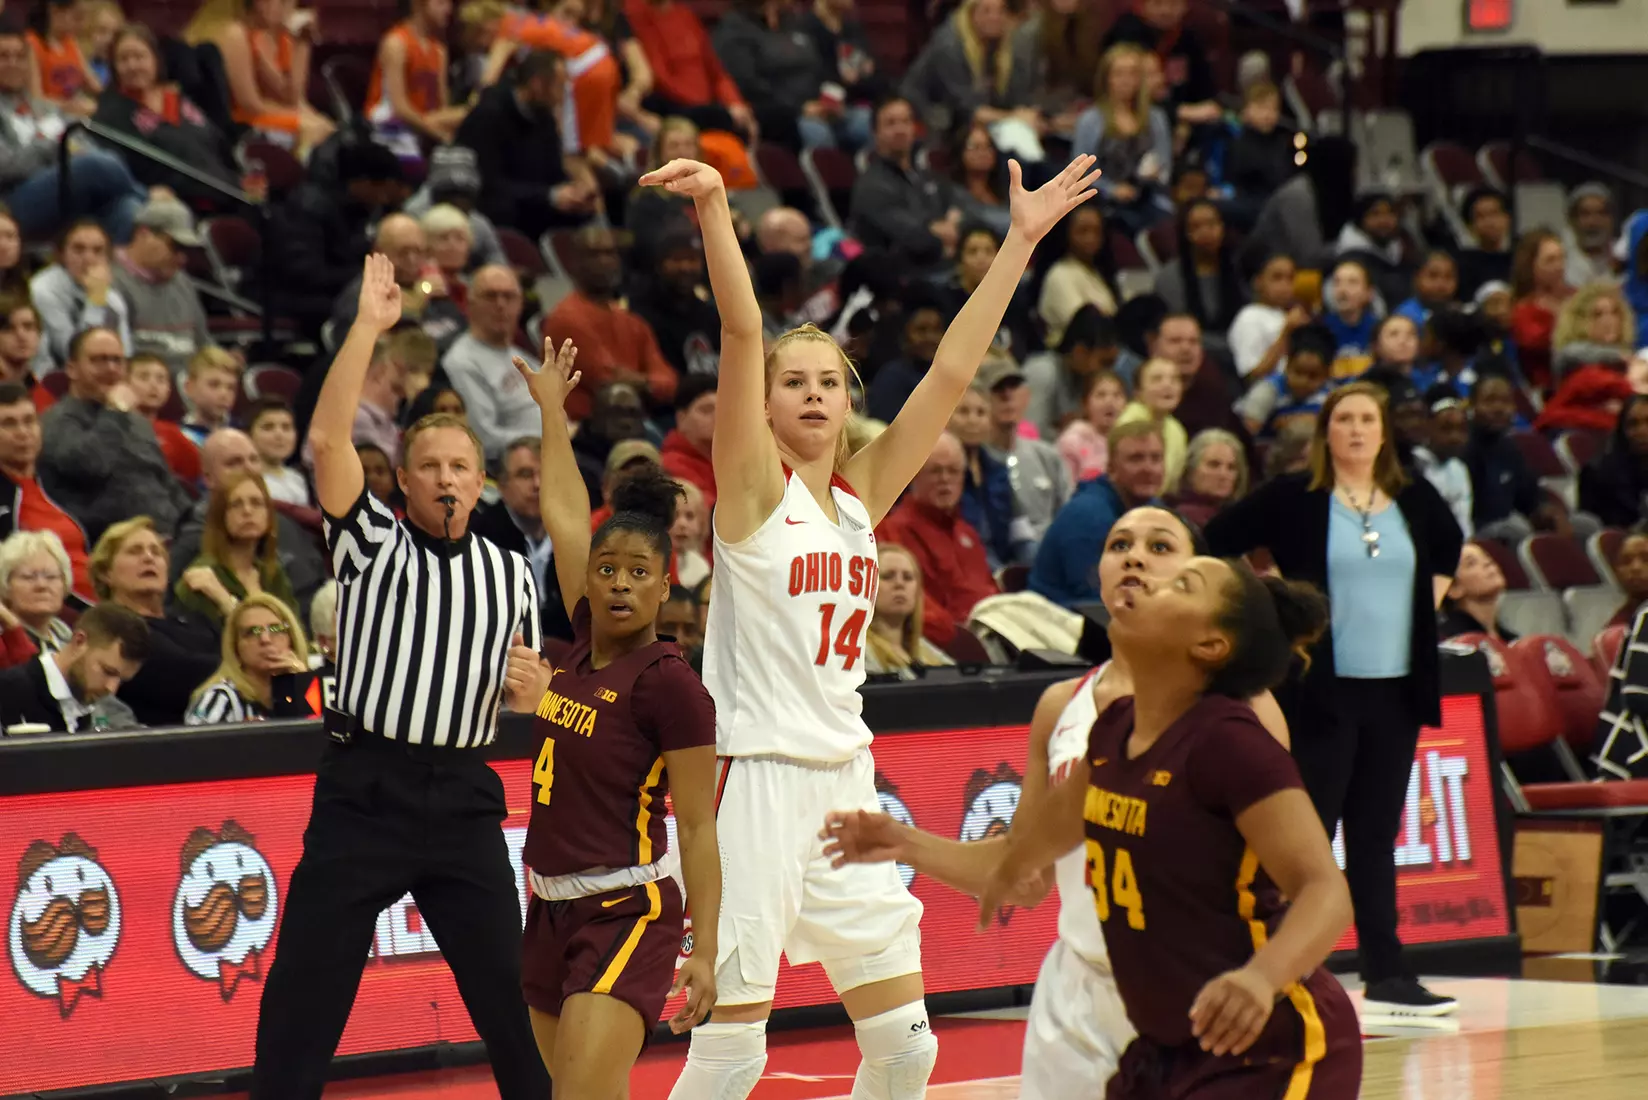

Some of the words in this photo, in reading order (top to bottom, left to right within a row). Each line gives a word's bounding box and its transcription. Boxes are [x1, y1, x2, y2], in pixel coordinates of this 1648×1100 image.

[788, 552, 842, 598] OHIO
[814, 602, 868, 672] 14
[532, 736, 556, 806] 4
[1085, 836, 1146, 931] 34
